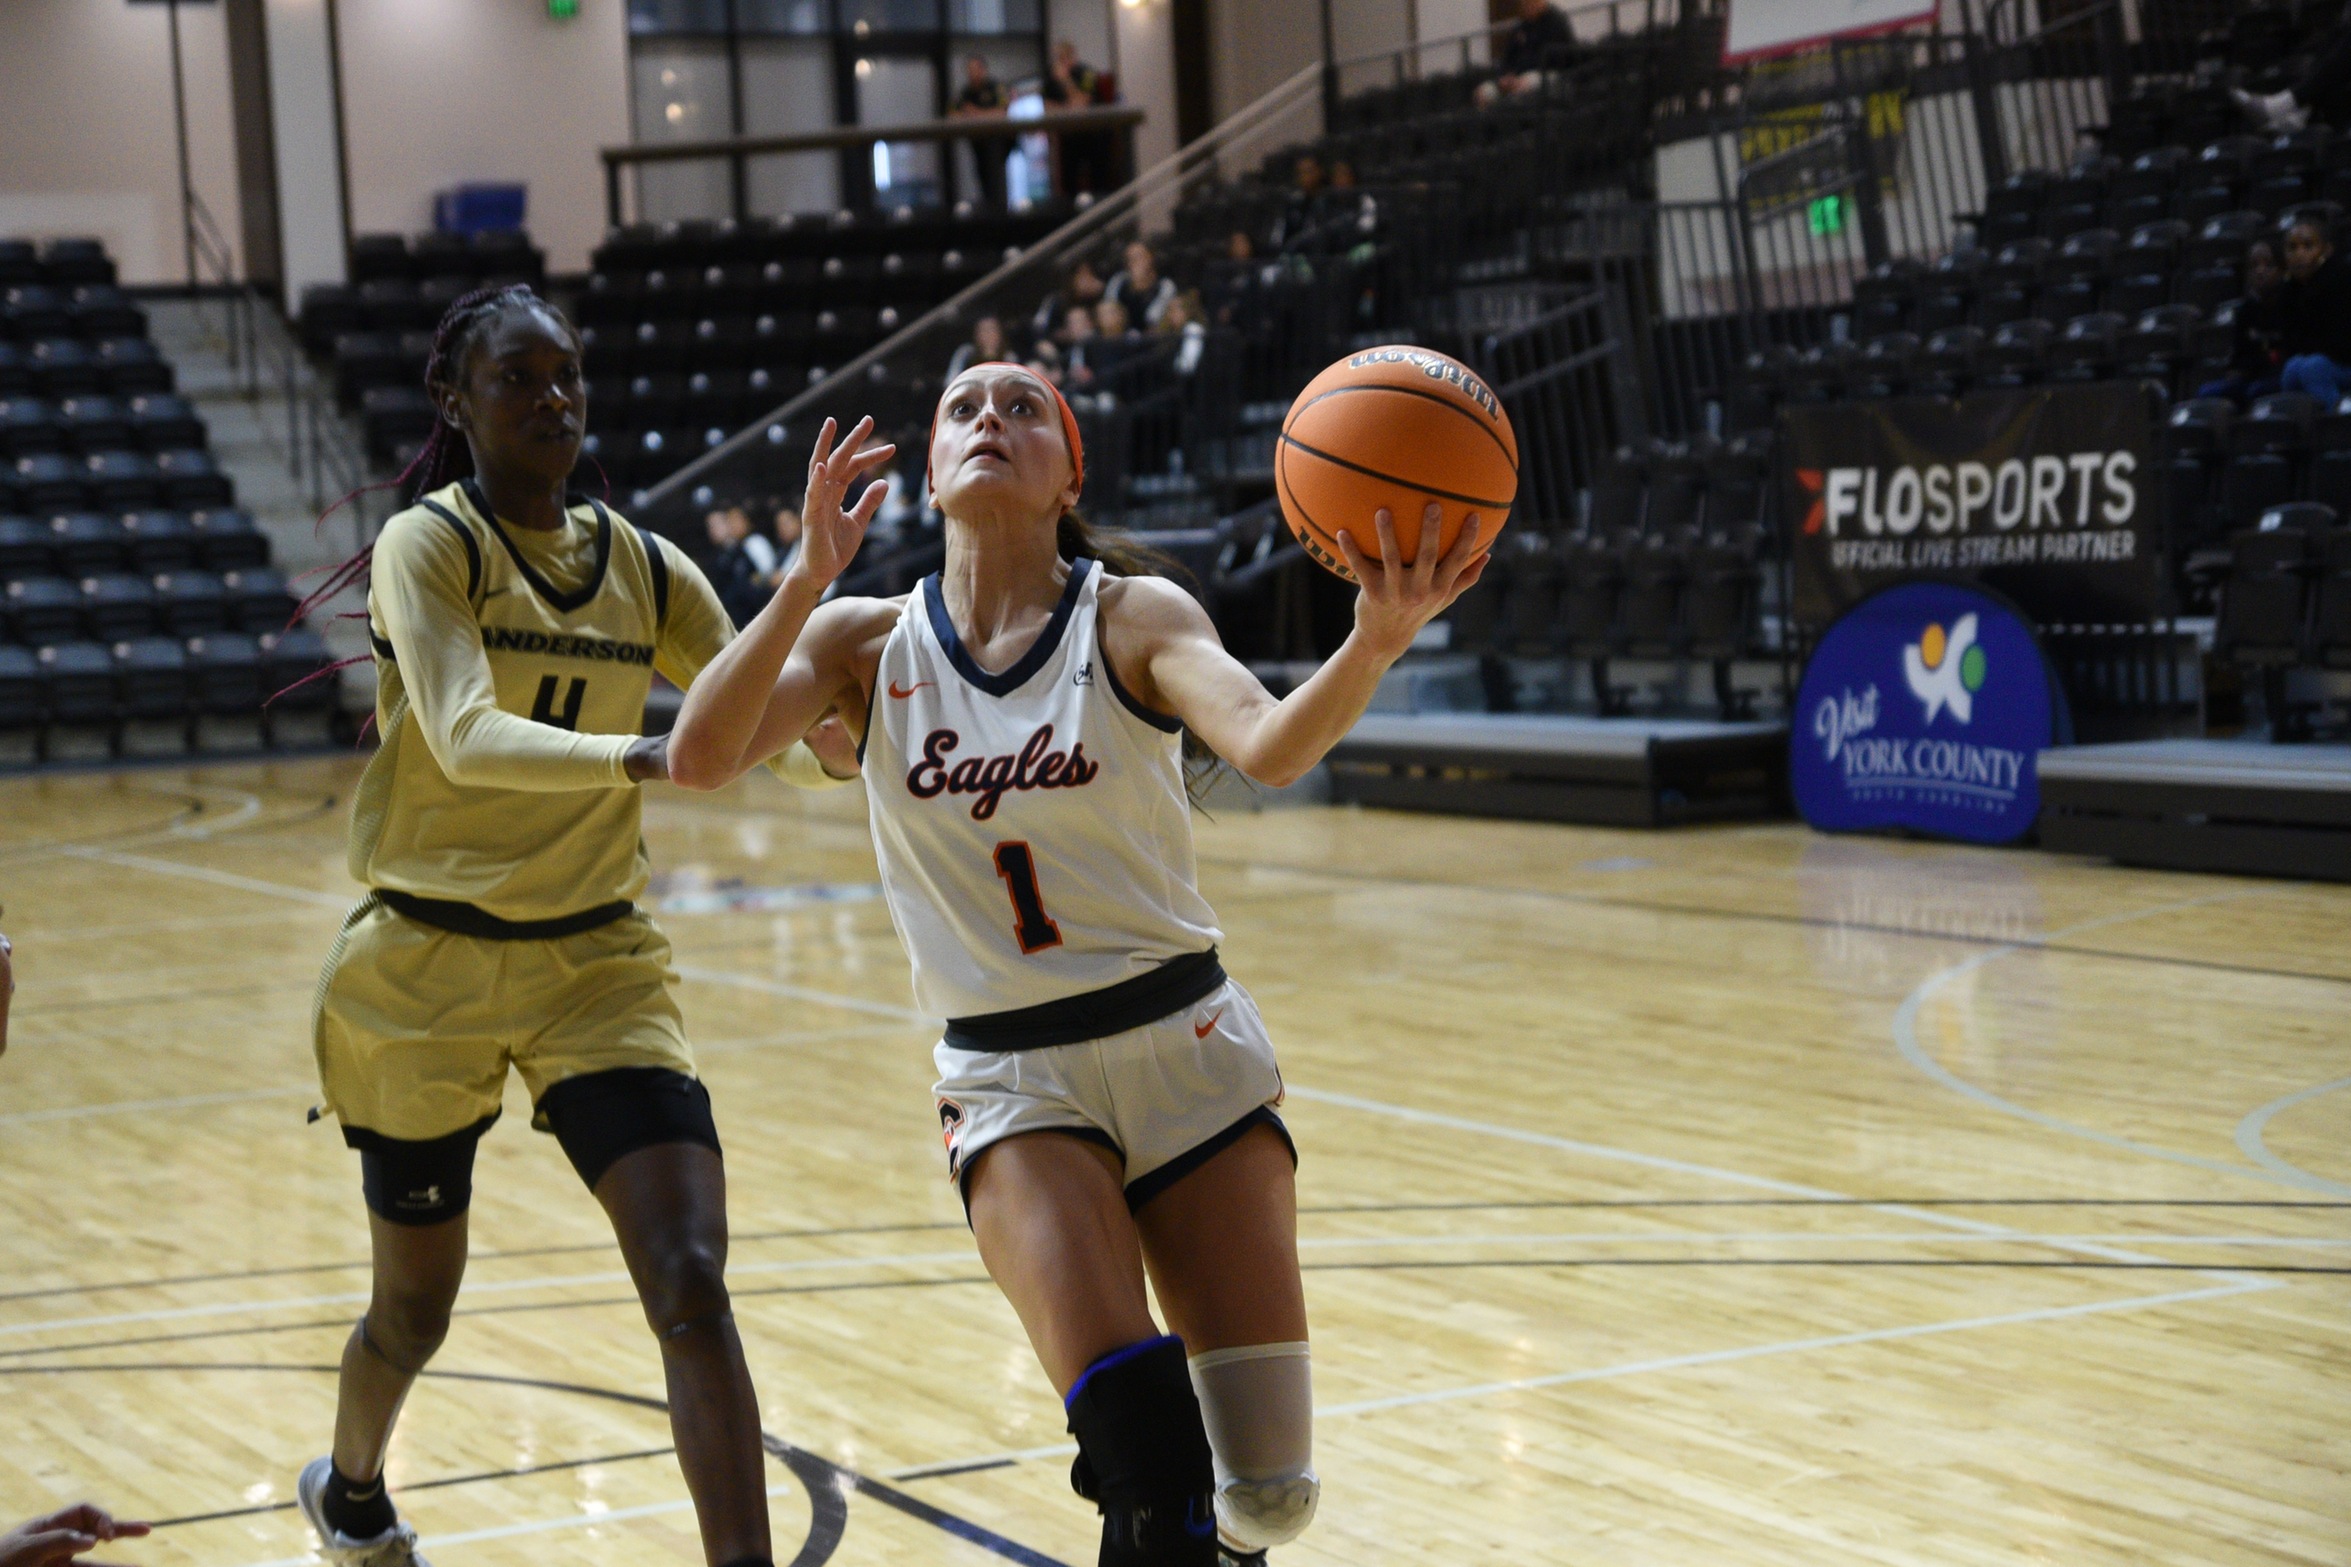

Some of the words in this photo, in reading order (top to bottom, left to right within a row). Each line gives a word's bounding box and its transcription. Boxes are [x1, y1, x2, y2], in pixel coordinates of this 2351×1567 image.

[1909, 536, 1954, 567] LIVE
[2042, 529, 2136, 561] PARTNER
[906, 723, 1099, 822] Eagles
[1843, 740, 1910, 777] YORK
[1913, 739, 2024, 790] COUNTY
[992, 840, 1064, 956] 1
